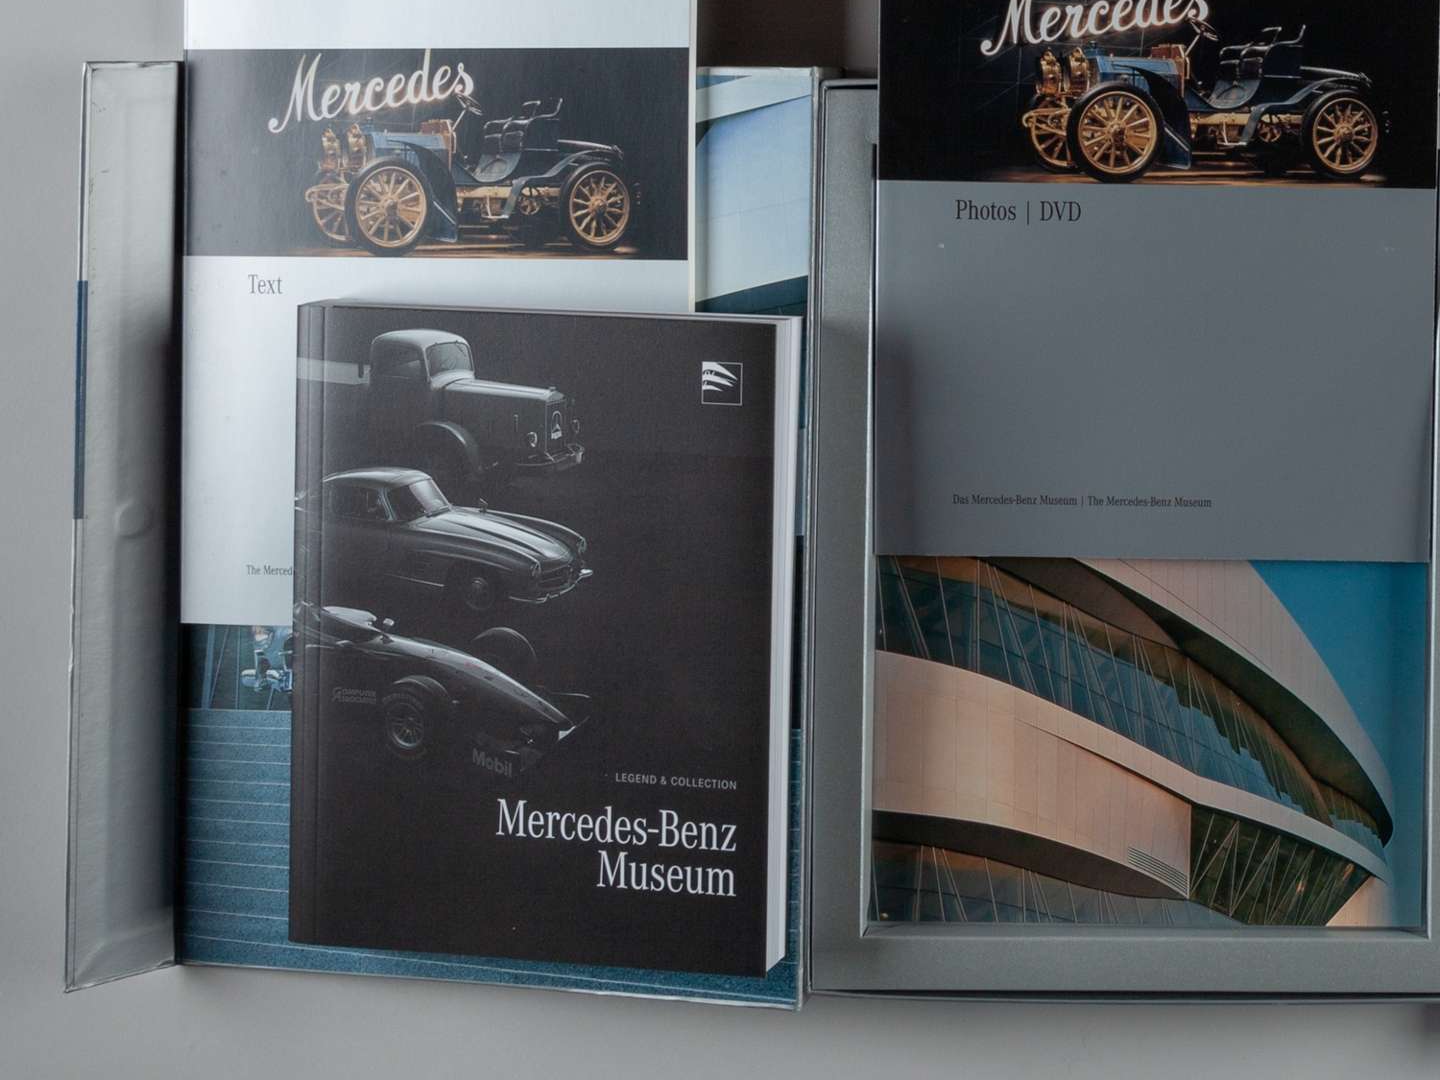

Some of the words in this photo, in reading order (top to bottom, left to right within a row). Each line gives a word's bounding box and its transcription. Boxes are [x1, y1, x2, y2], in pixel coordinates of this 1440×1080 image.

[268, 48, 474, 134] Mercedes
[956, 199, 1016, 221] Photos
[1040, 200, 1081, 222] DVD
[248, 274, 282, 294] Text
[952, 494, 969, 505] Das
[971, 494, 1037, 506] Mercedes-Benz
[1040, 495, 1077, 506] Museum
[1105, 496, 1171, 507] Mercedes-Benz
[1174, 497, 1211, 508] Museum
[472, 748, 512, 778] Mobil
[615, 772, 657, 787] LEGEND
[660, 775, 668, 786] &
[670, 776, 738, 791] COLLECTION
[496, 797, 738, 852] Mercedes-Benz
[597, 850, 736, 897] Museum
